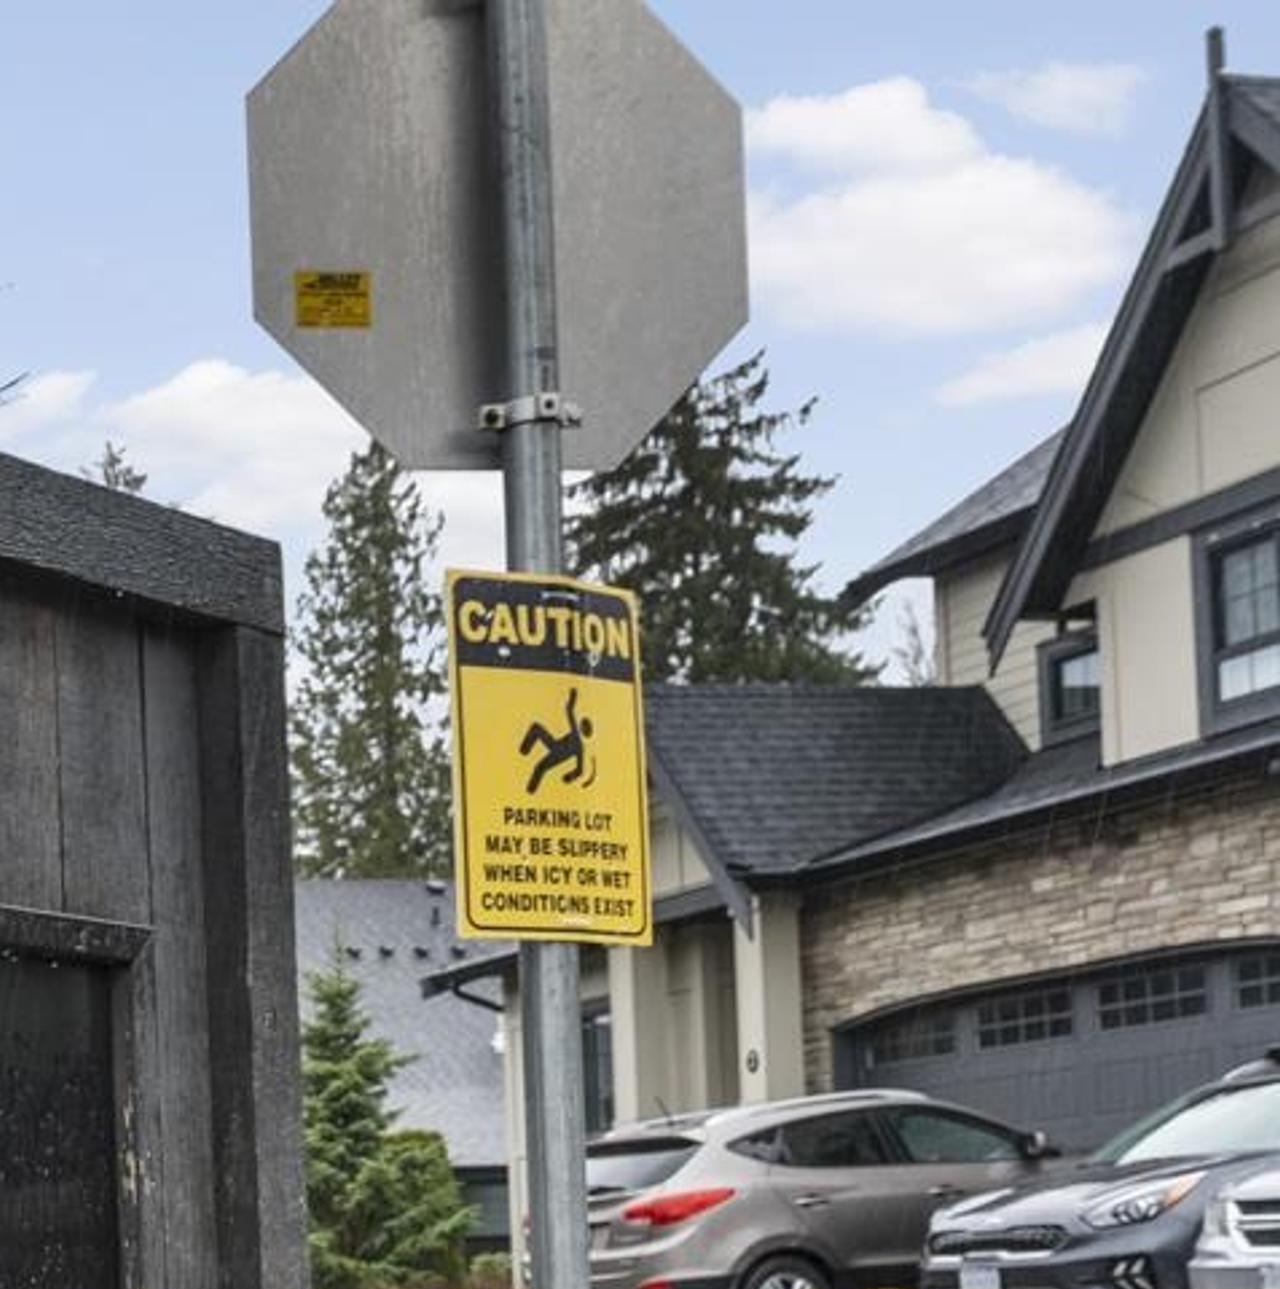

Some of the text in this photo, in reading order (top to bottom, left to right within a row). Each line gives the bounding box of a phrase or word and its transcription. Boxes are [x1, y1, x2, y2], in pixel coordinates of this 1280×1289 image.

[458, 600, 630, 660] CAUTION
[503, 806, 613, 831] PARKING LOT
[485, 835, 628, 861] MAY BE SLIPPERY
[484, 864, 631, 889] WHEN ICY OR WET
[481, 891, 635, 917] CONDITIONS EXIST
